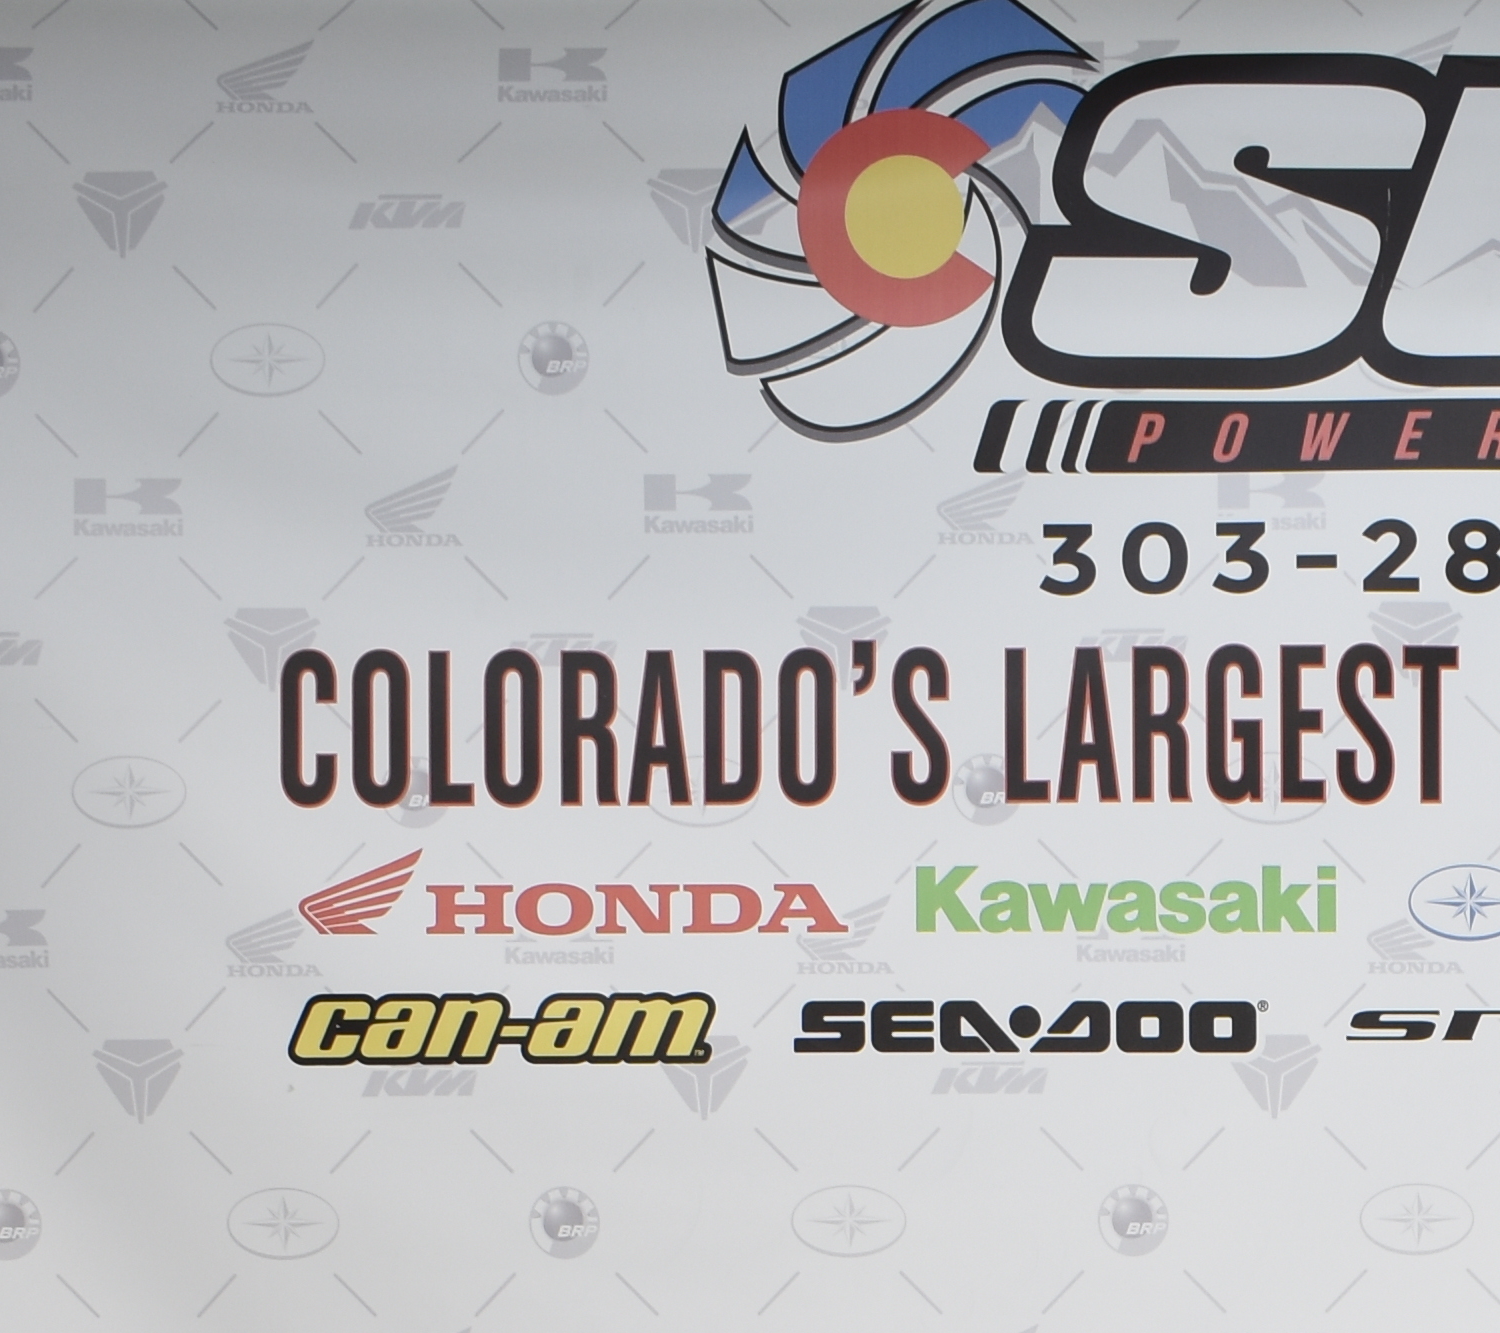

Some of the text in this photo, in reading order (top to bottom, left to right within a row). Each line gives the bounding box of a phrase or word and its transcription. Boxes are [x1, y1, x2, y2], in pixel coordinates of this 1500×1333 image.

[497, 85, 607, 102] Kawasaki
[216, 99, 313, 113] HONDA
[349, 193, 464, 229] KTM
[73, 518, 183, 536] Kawasaki
[644, 515, 753, 534] Kawasaki
[366, 532, 462, 547] HONDA
[937, 531, 1035, 546] HONDA
[280, 640, 949, 808] COLORADO'S
[1005, 642, 1460, 804] LARGEST
[918, 867, 1336, 934] Kawasaki
[426, 883, 848, 936] HONDA
[505, 947, 614, 964] Kawasaki
[1076, 944, 1185, 962] Kawasaki
[227, 962, 322, 977] HONDA
[797, 959, 893, 974] HONDA
[1369, 959, 1463, 974] HONDA
[932, 1058, 1048, 1096] KTM
[558, 1224, 597, 1237] BRP
